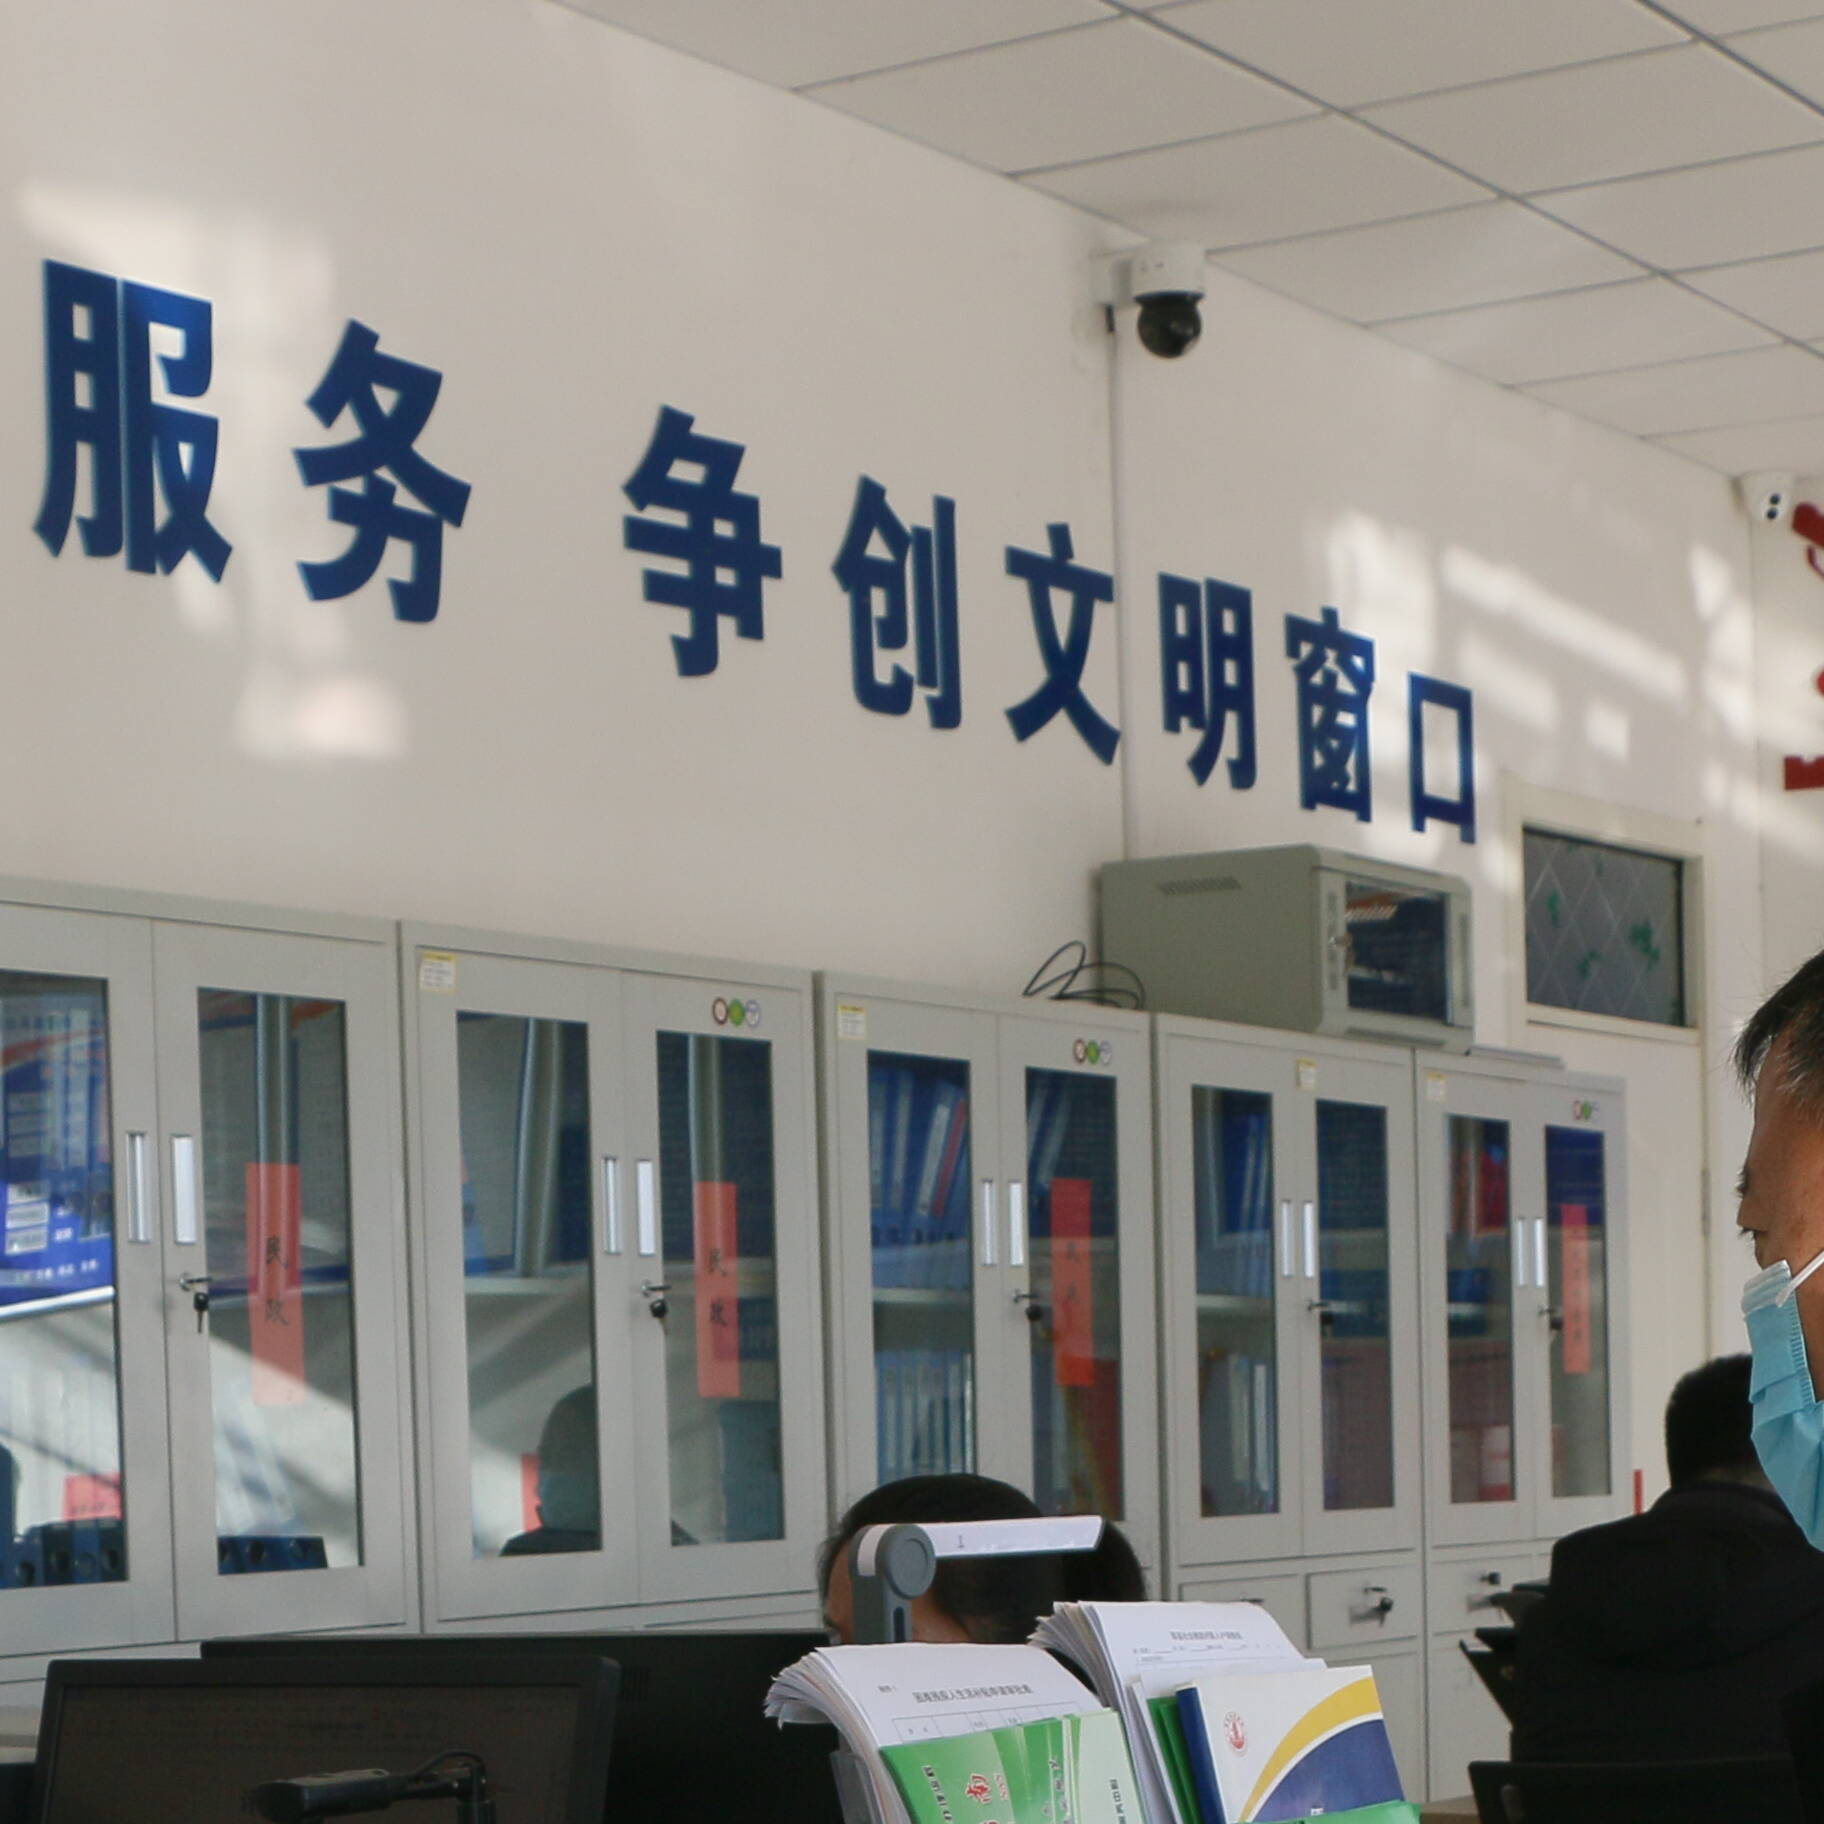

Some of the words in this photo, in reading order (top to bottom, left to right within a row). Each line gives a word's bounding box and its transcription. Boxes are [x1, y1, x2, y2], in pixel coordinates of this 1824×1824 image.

[623, 403, 1477, 845] 争创文明窗口
